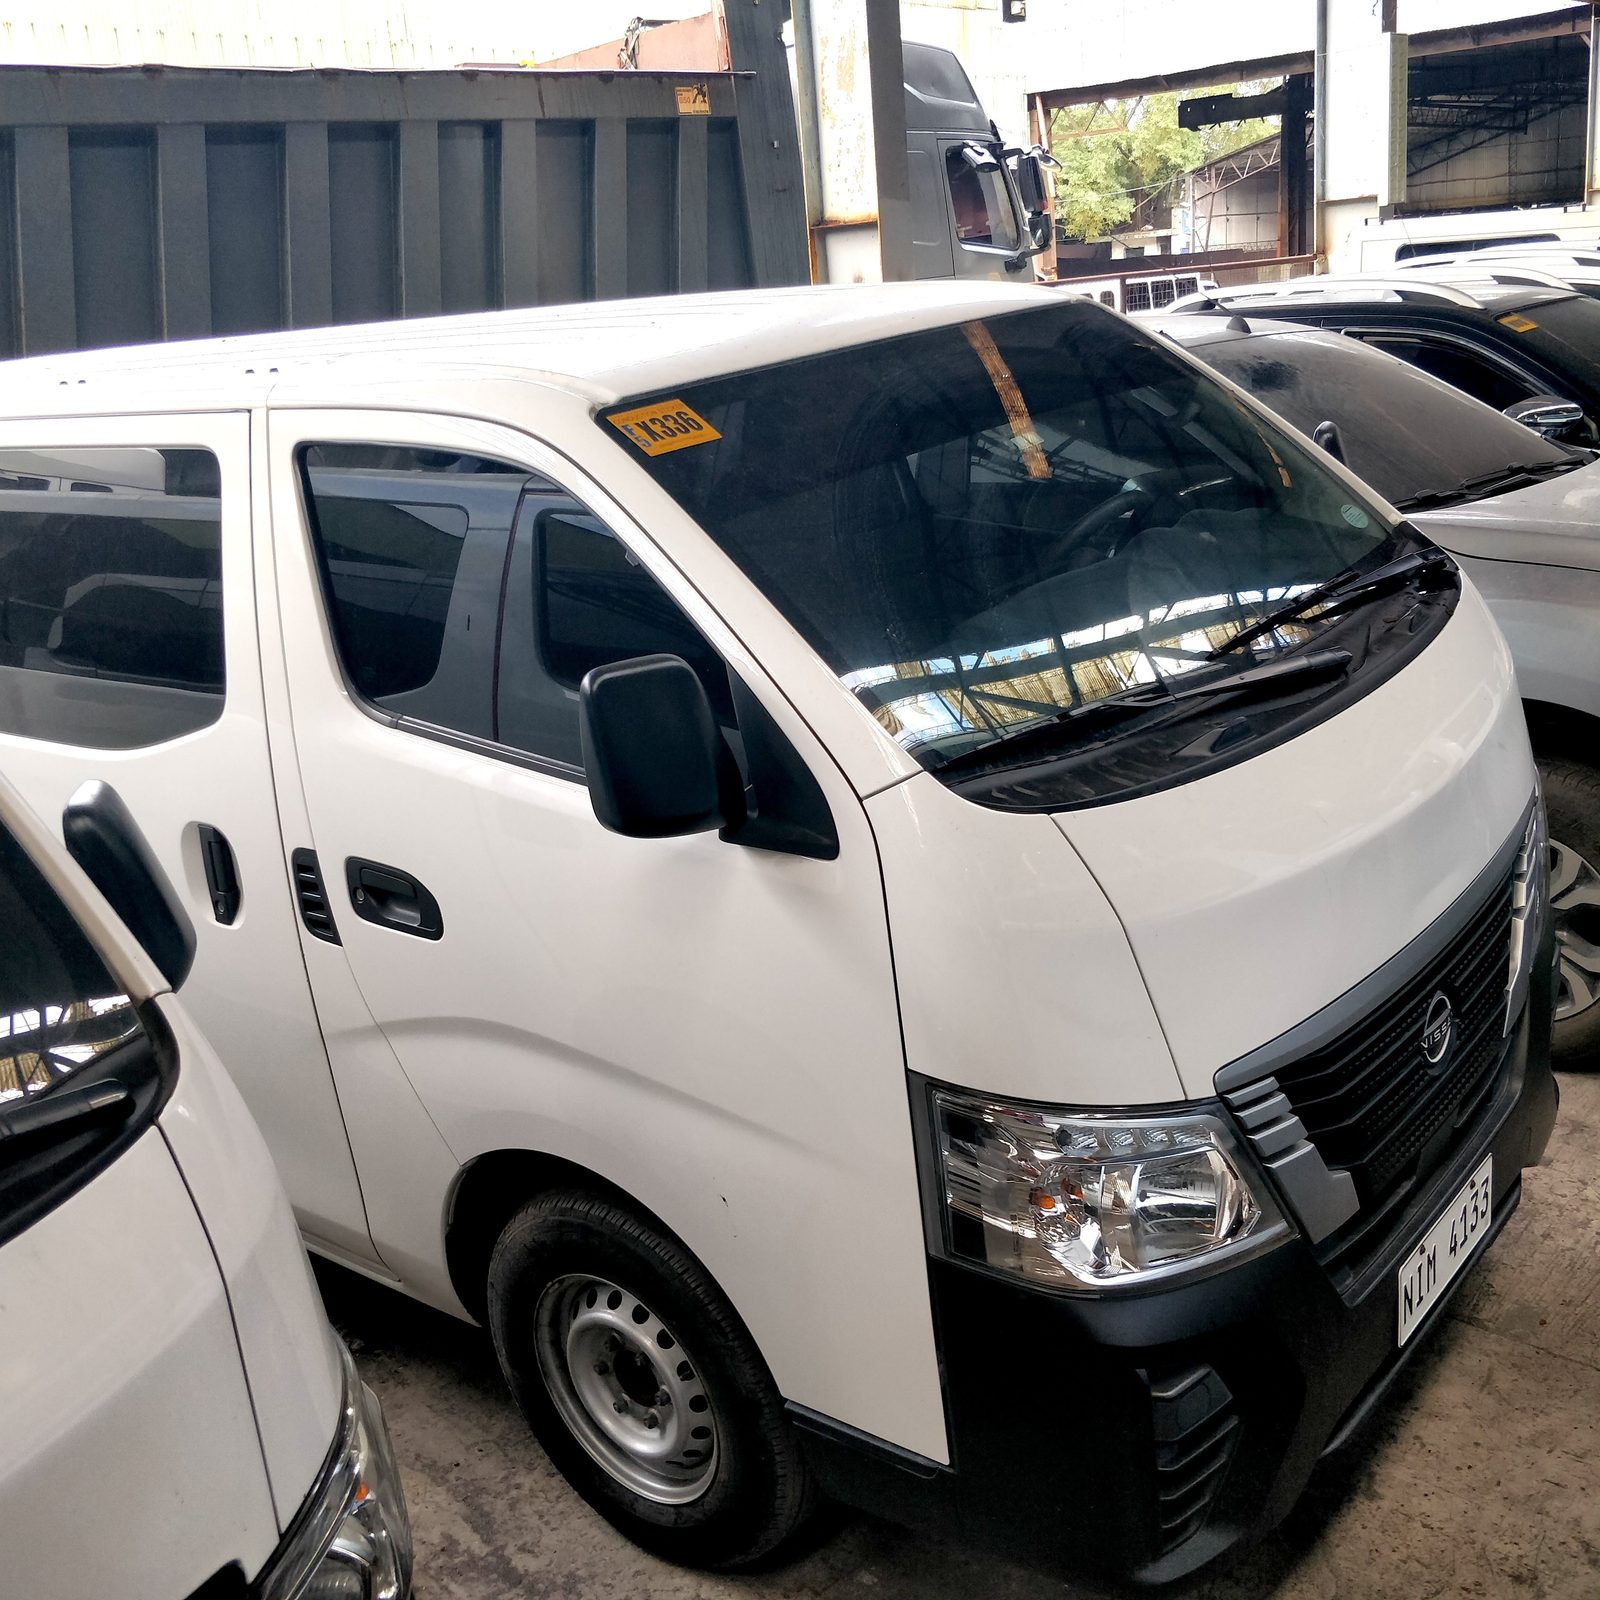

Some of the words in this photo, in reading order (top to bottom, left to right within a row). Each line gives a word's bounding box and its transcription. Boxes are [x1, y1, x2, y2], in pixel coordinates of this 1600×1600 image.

[634, 411, 704, 442] X336
[1420, 1016, 1451, 1049] NISS
[1403, 1244, 1437, 1325] NIM
[1449, 1175, 1489, 1257] 4133
